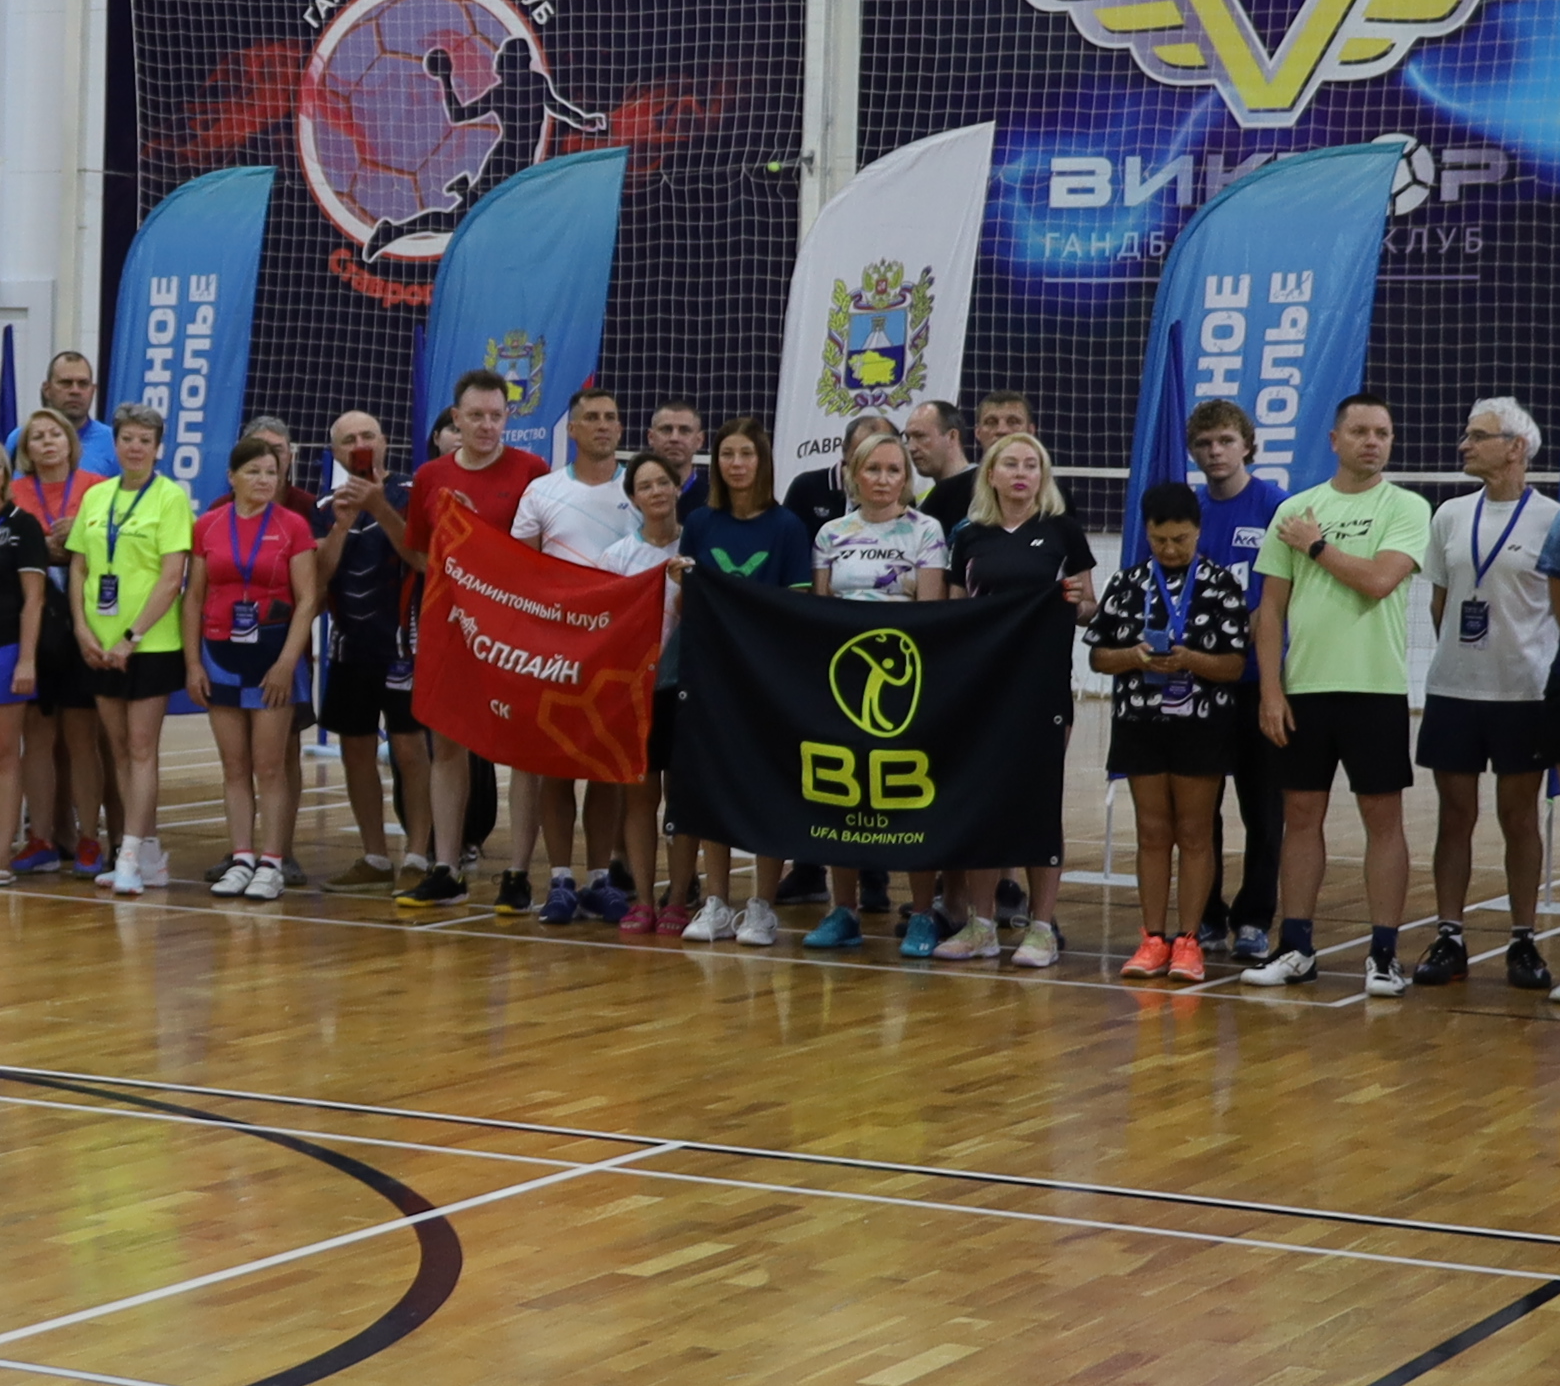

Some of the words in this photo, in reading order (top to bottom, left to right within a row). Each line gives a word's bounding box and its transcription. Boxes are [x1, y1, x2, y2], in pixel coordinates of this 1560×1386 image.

[1044, 228, 1178, 261] ГАНДБ
[797, 437, 844, 459] СТАВР
[860, 549, 905, 561] YONEX
[444, 556, 562, 622] Бадминтонный
[566, 611, 611, 631] клуб
[800, 740, 936, 810] BB
[845, 812, 889, 828] club
[810, 825, 838, 840] UFA
[841, 830, 925, 844] BADMINTON
